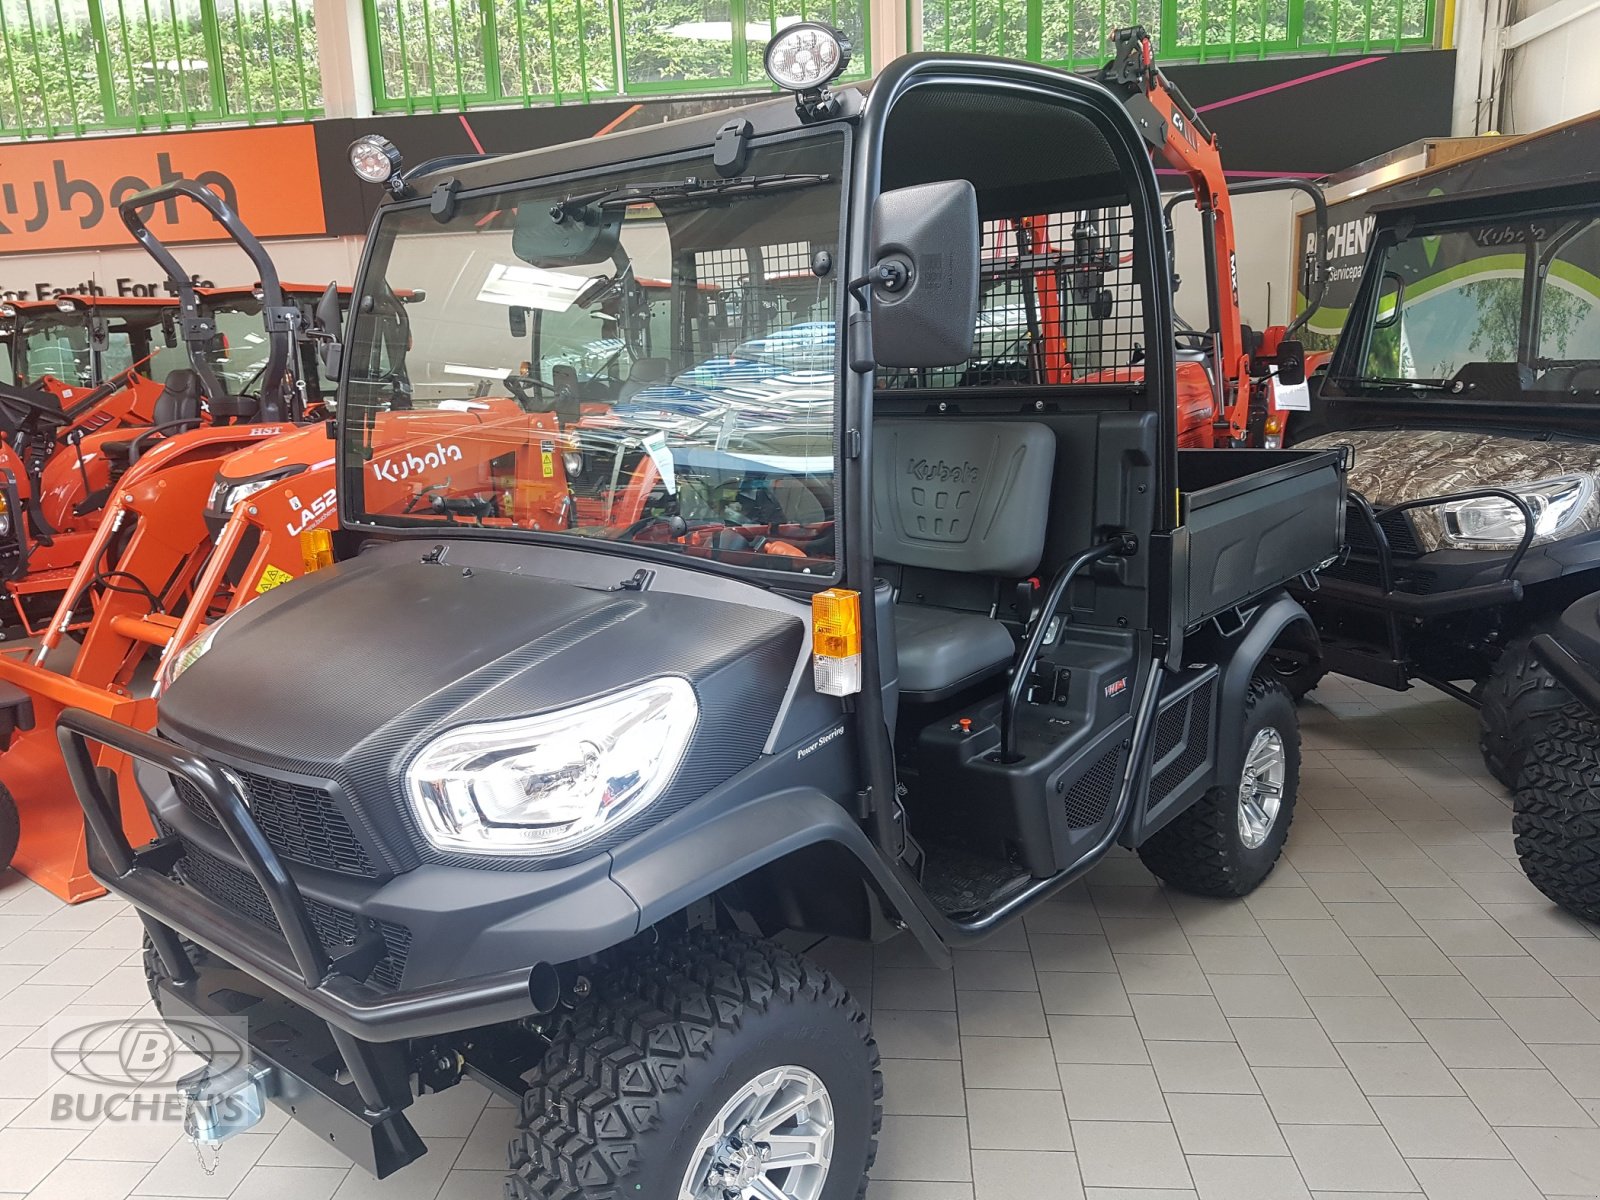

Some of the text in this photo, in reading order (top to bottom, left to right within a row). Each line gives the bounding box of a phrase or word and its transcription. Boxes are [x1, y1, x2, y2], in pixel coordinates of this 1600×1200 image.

[35, 280, 104, 301] Earth
[117, 277, 158, 298] For
[249, 426, 283, 436] HST
[373, 443, 462, 483] Kubota
[907, 458, 979, 482] Kubota
[797, 726, 845, 759] Power Steering
